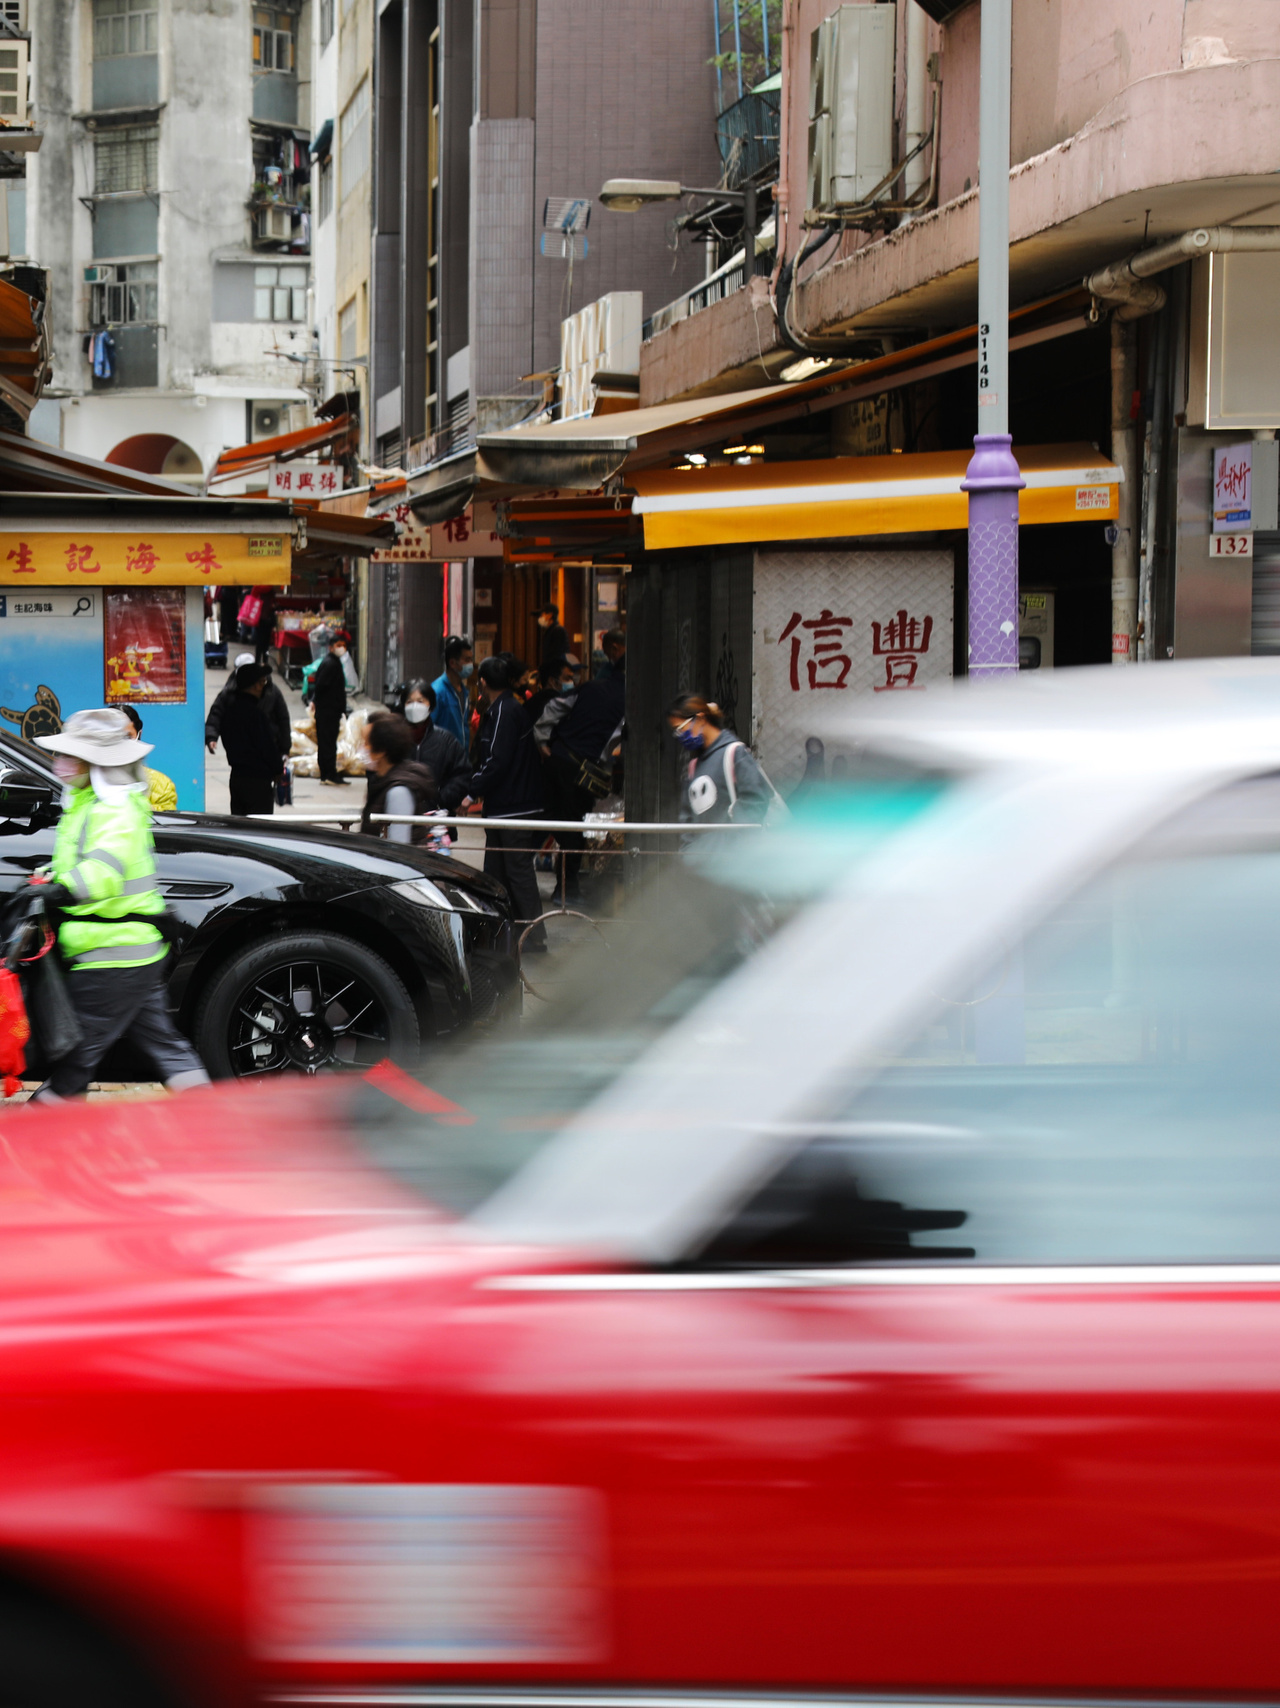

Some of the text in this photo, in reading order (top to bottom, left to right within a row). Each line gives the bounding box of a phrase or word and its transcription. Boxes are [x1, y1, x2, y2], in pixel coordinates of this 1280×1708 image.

[979, 323, 990, 389] 31148
[6, 542, 223, 574] 生記海味
[1215, 536, 1248, 554] 132
[13, 601, 54, 614] 生記海味
[777, 608, 933, 693] 信豐
